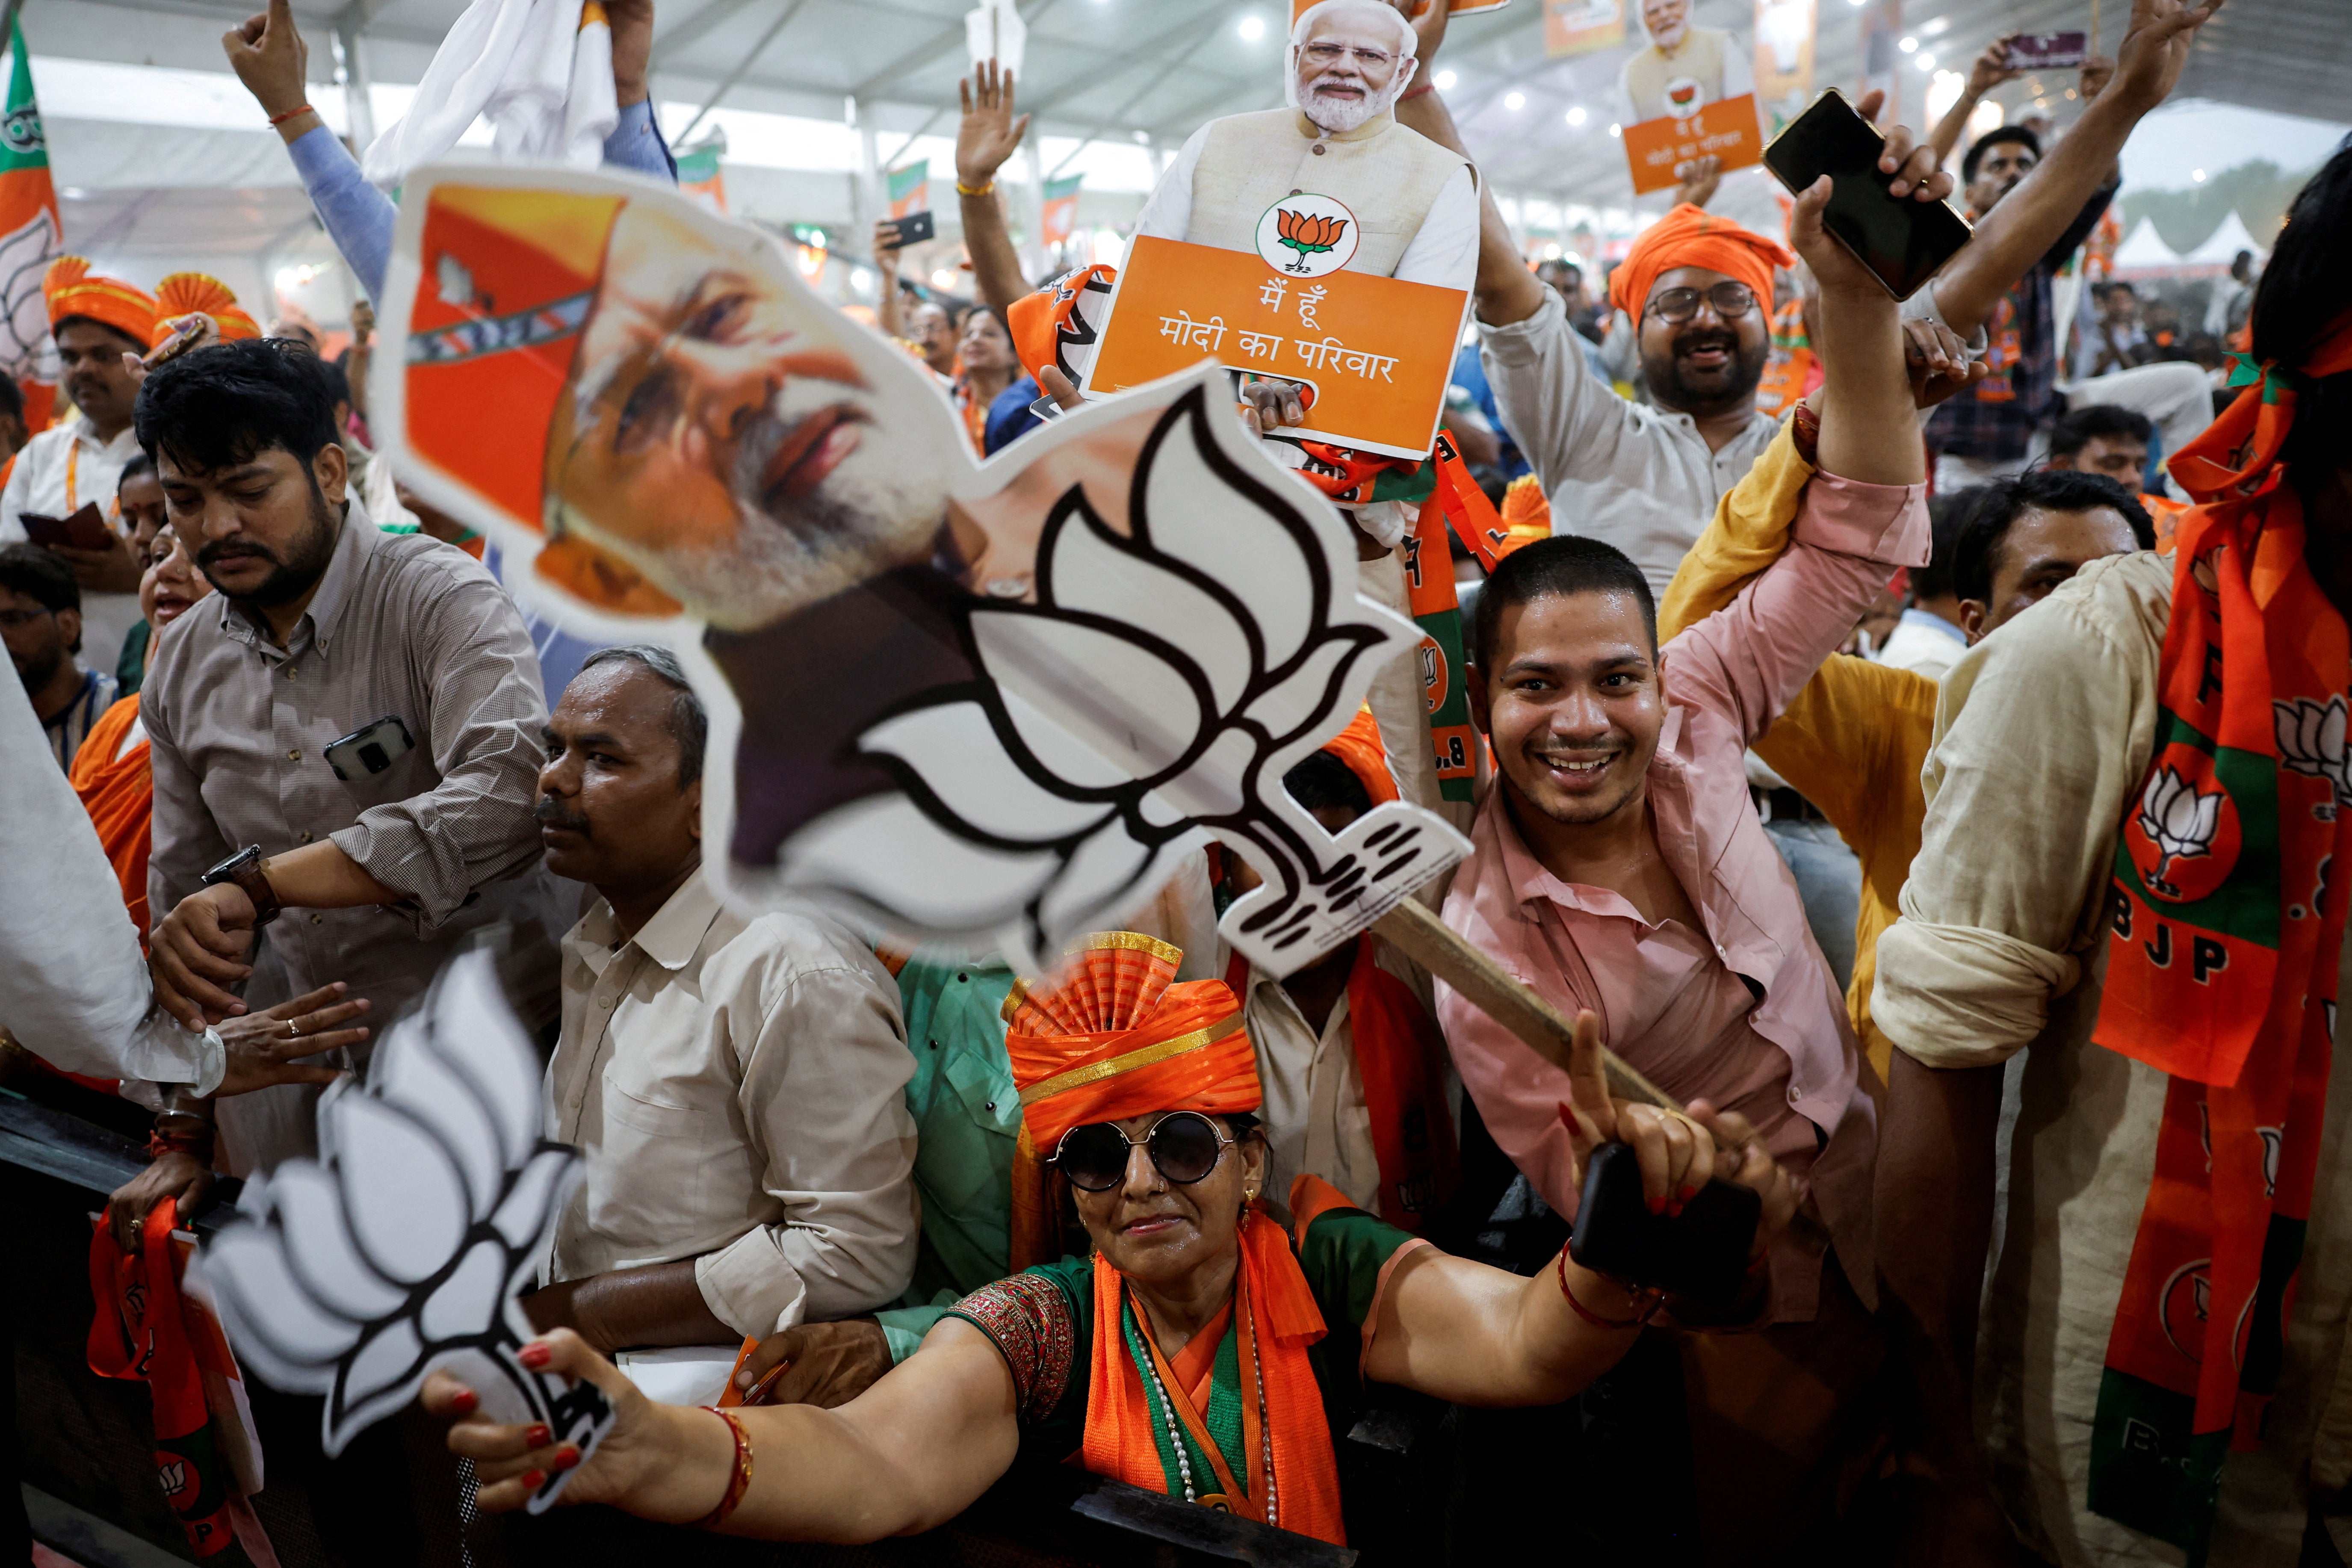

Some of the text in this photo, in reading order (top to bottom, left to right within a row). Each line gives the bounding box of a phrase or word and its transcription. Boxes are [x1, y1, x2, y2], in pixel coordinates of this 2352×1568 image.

[1259, 277, 1328, 331] मैं हूँ
[1159, 310, 1400, 383] मोदी का परिवार
